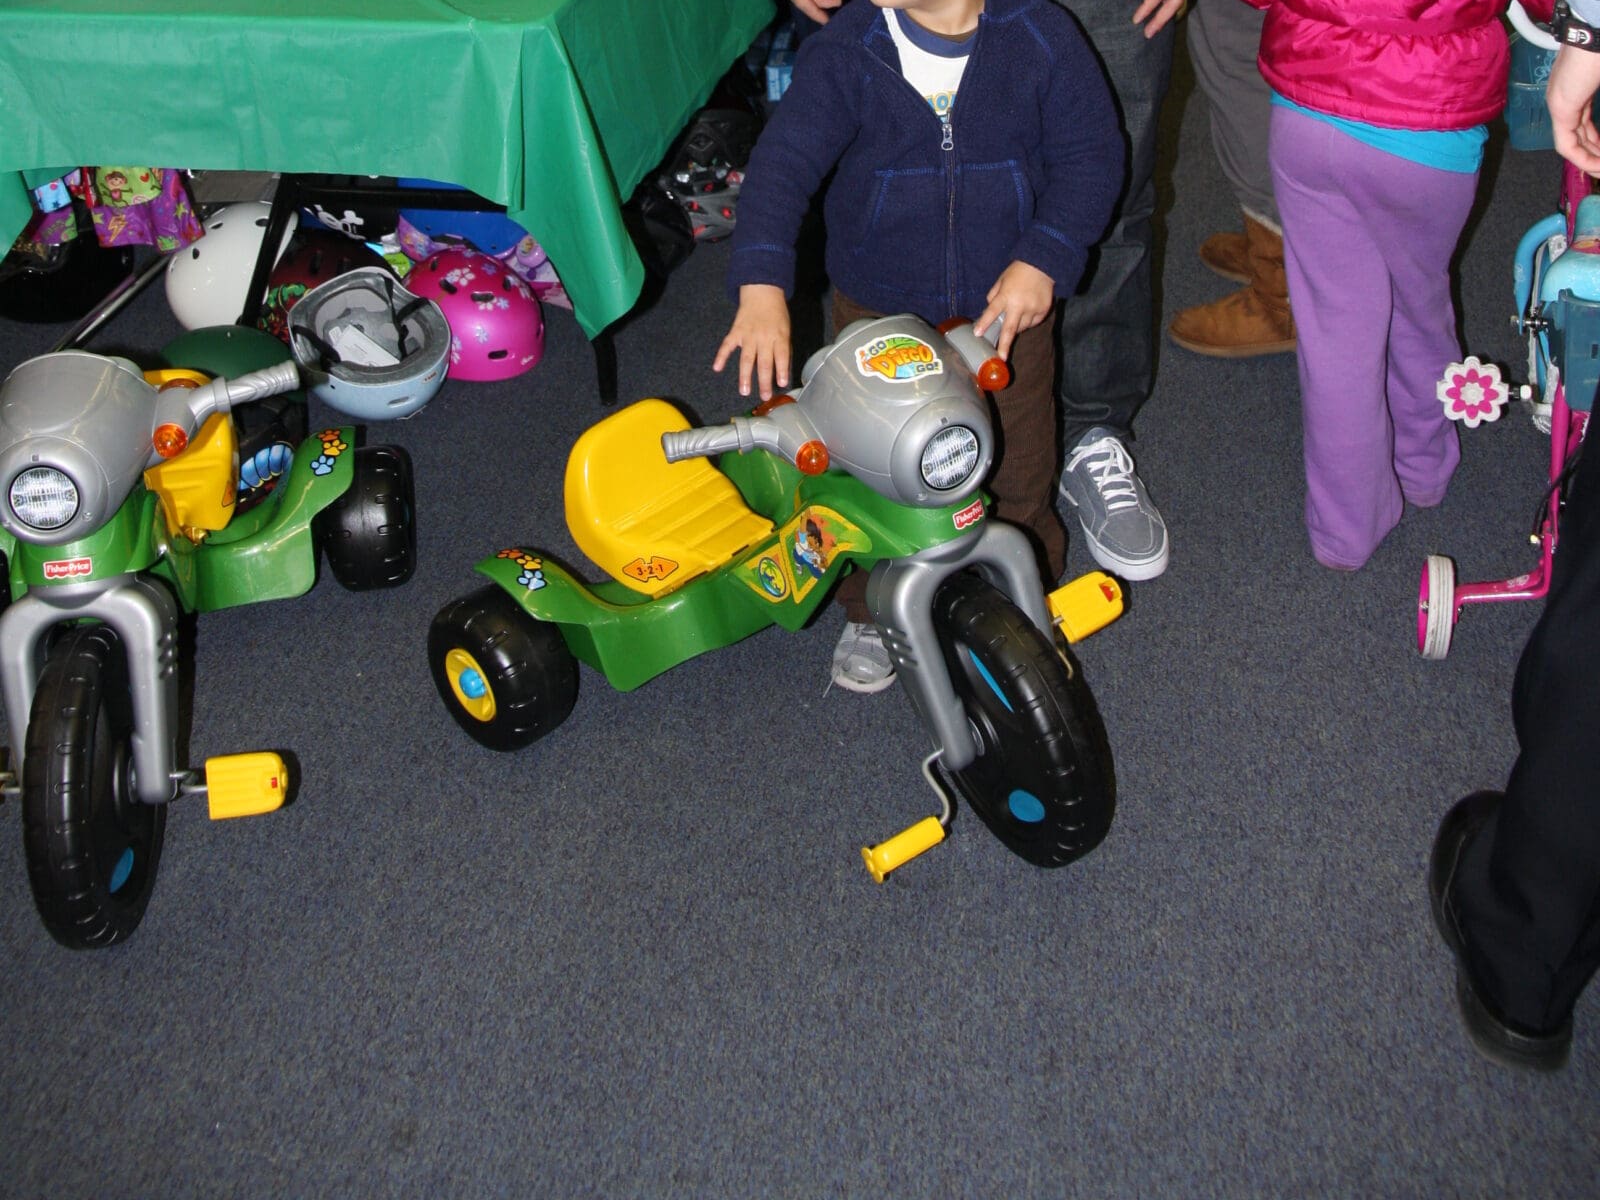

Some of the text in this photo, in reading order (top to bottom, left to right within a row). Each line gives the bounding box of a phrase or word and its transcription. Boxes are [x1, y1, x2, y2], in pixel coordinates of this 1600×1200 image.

[868, 340, 887, 356] GO
[917, 361, 939, 373] GO!
[46, 562, 90, 573] Fisher-Price
